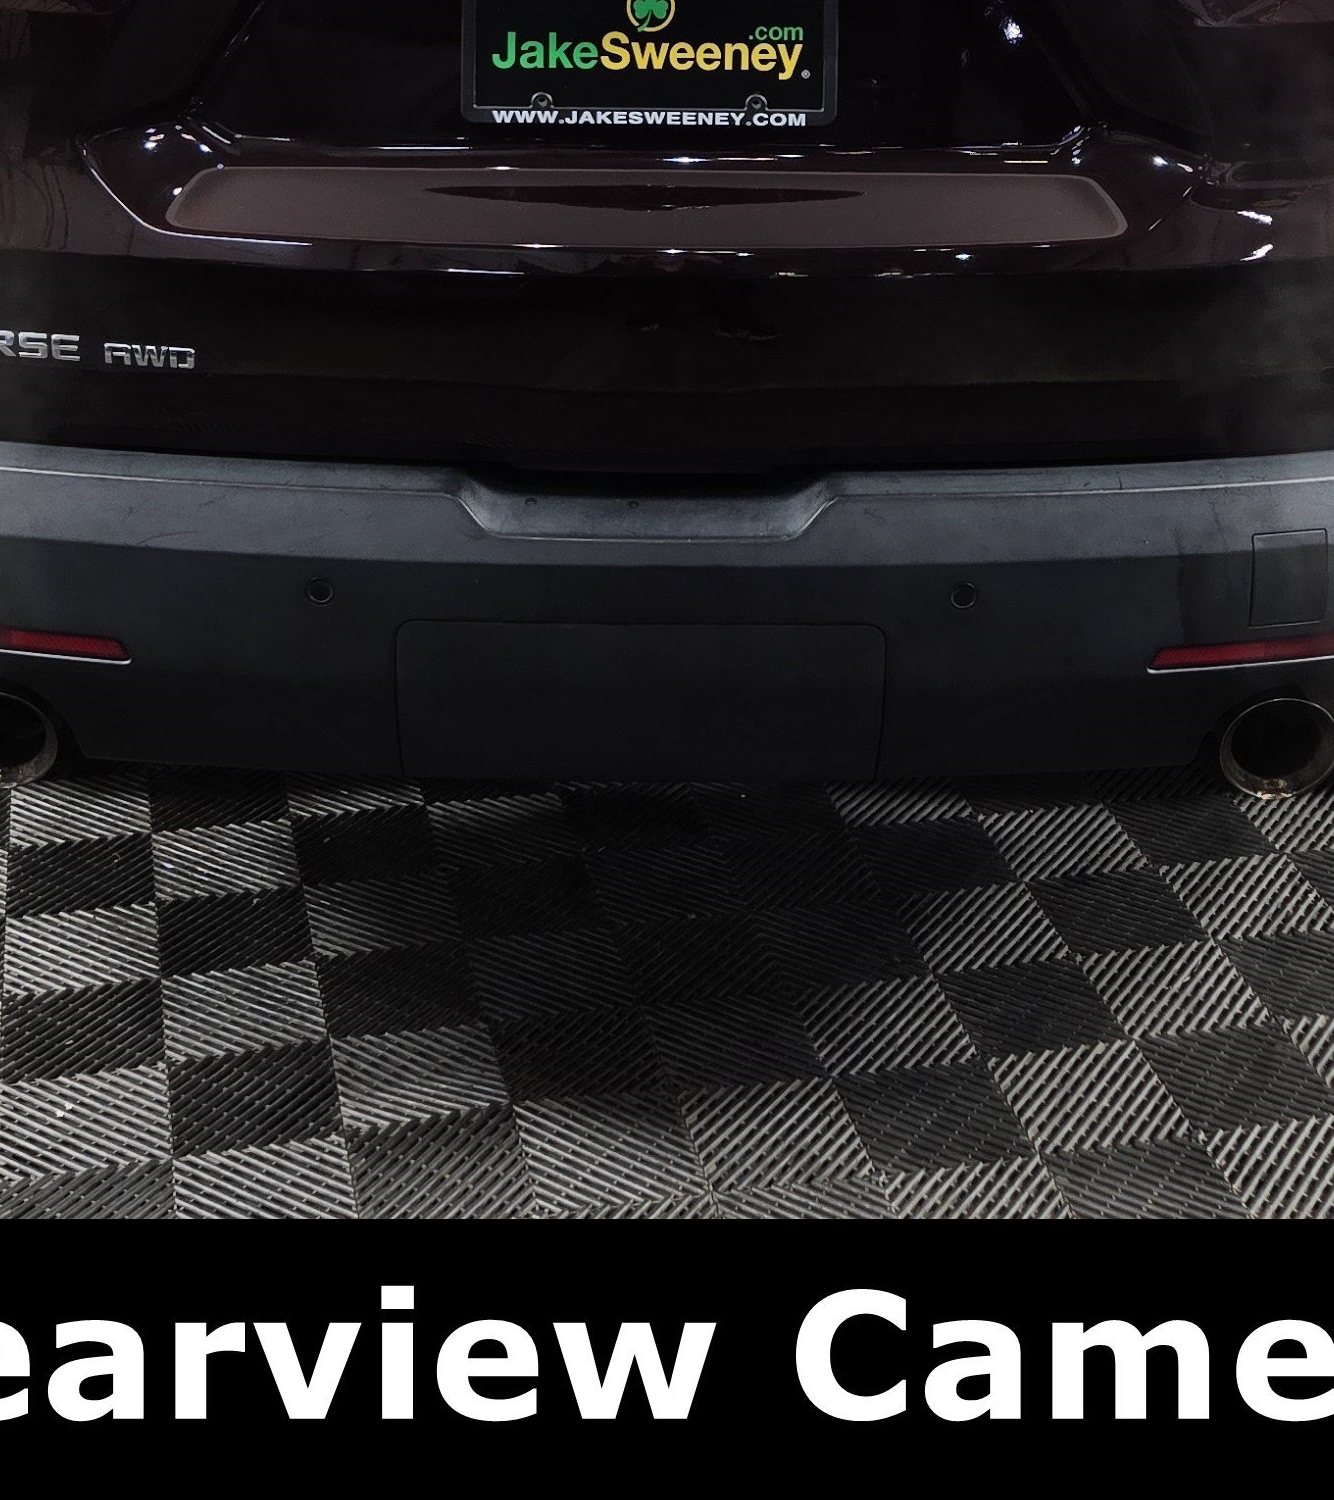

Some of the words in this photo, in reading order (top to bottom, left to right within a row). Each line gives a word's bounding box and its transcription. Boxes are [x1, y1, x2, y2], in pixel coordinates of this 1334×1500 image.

[748, 25, 804, 41] .com
[492, 31, 804, 81] JakeSweeney
[492, 110, 807, 127] WWW.JAKESWEENEY.COM
[103, 341, 196, 370] AWD
